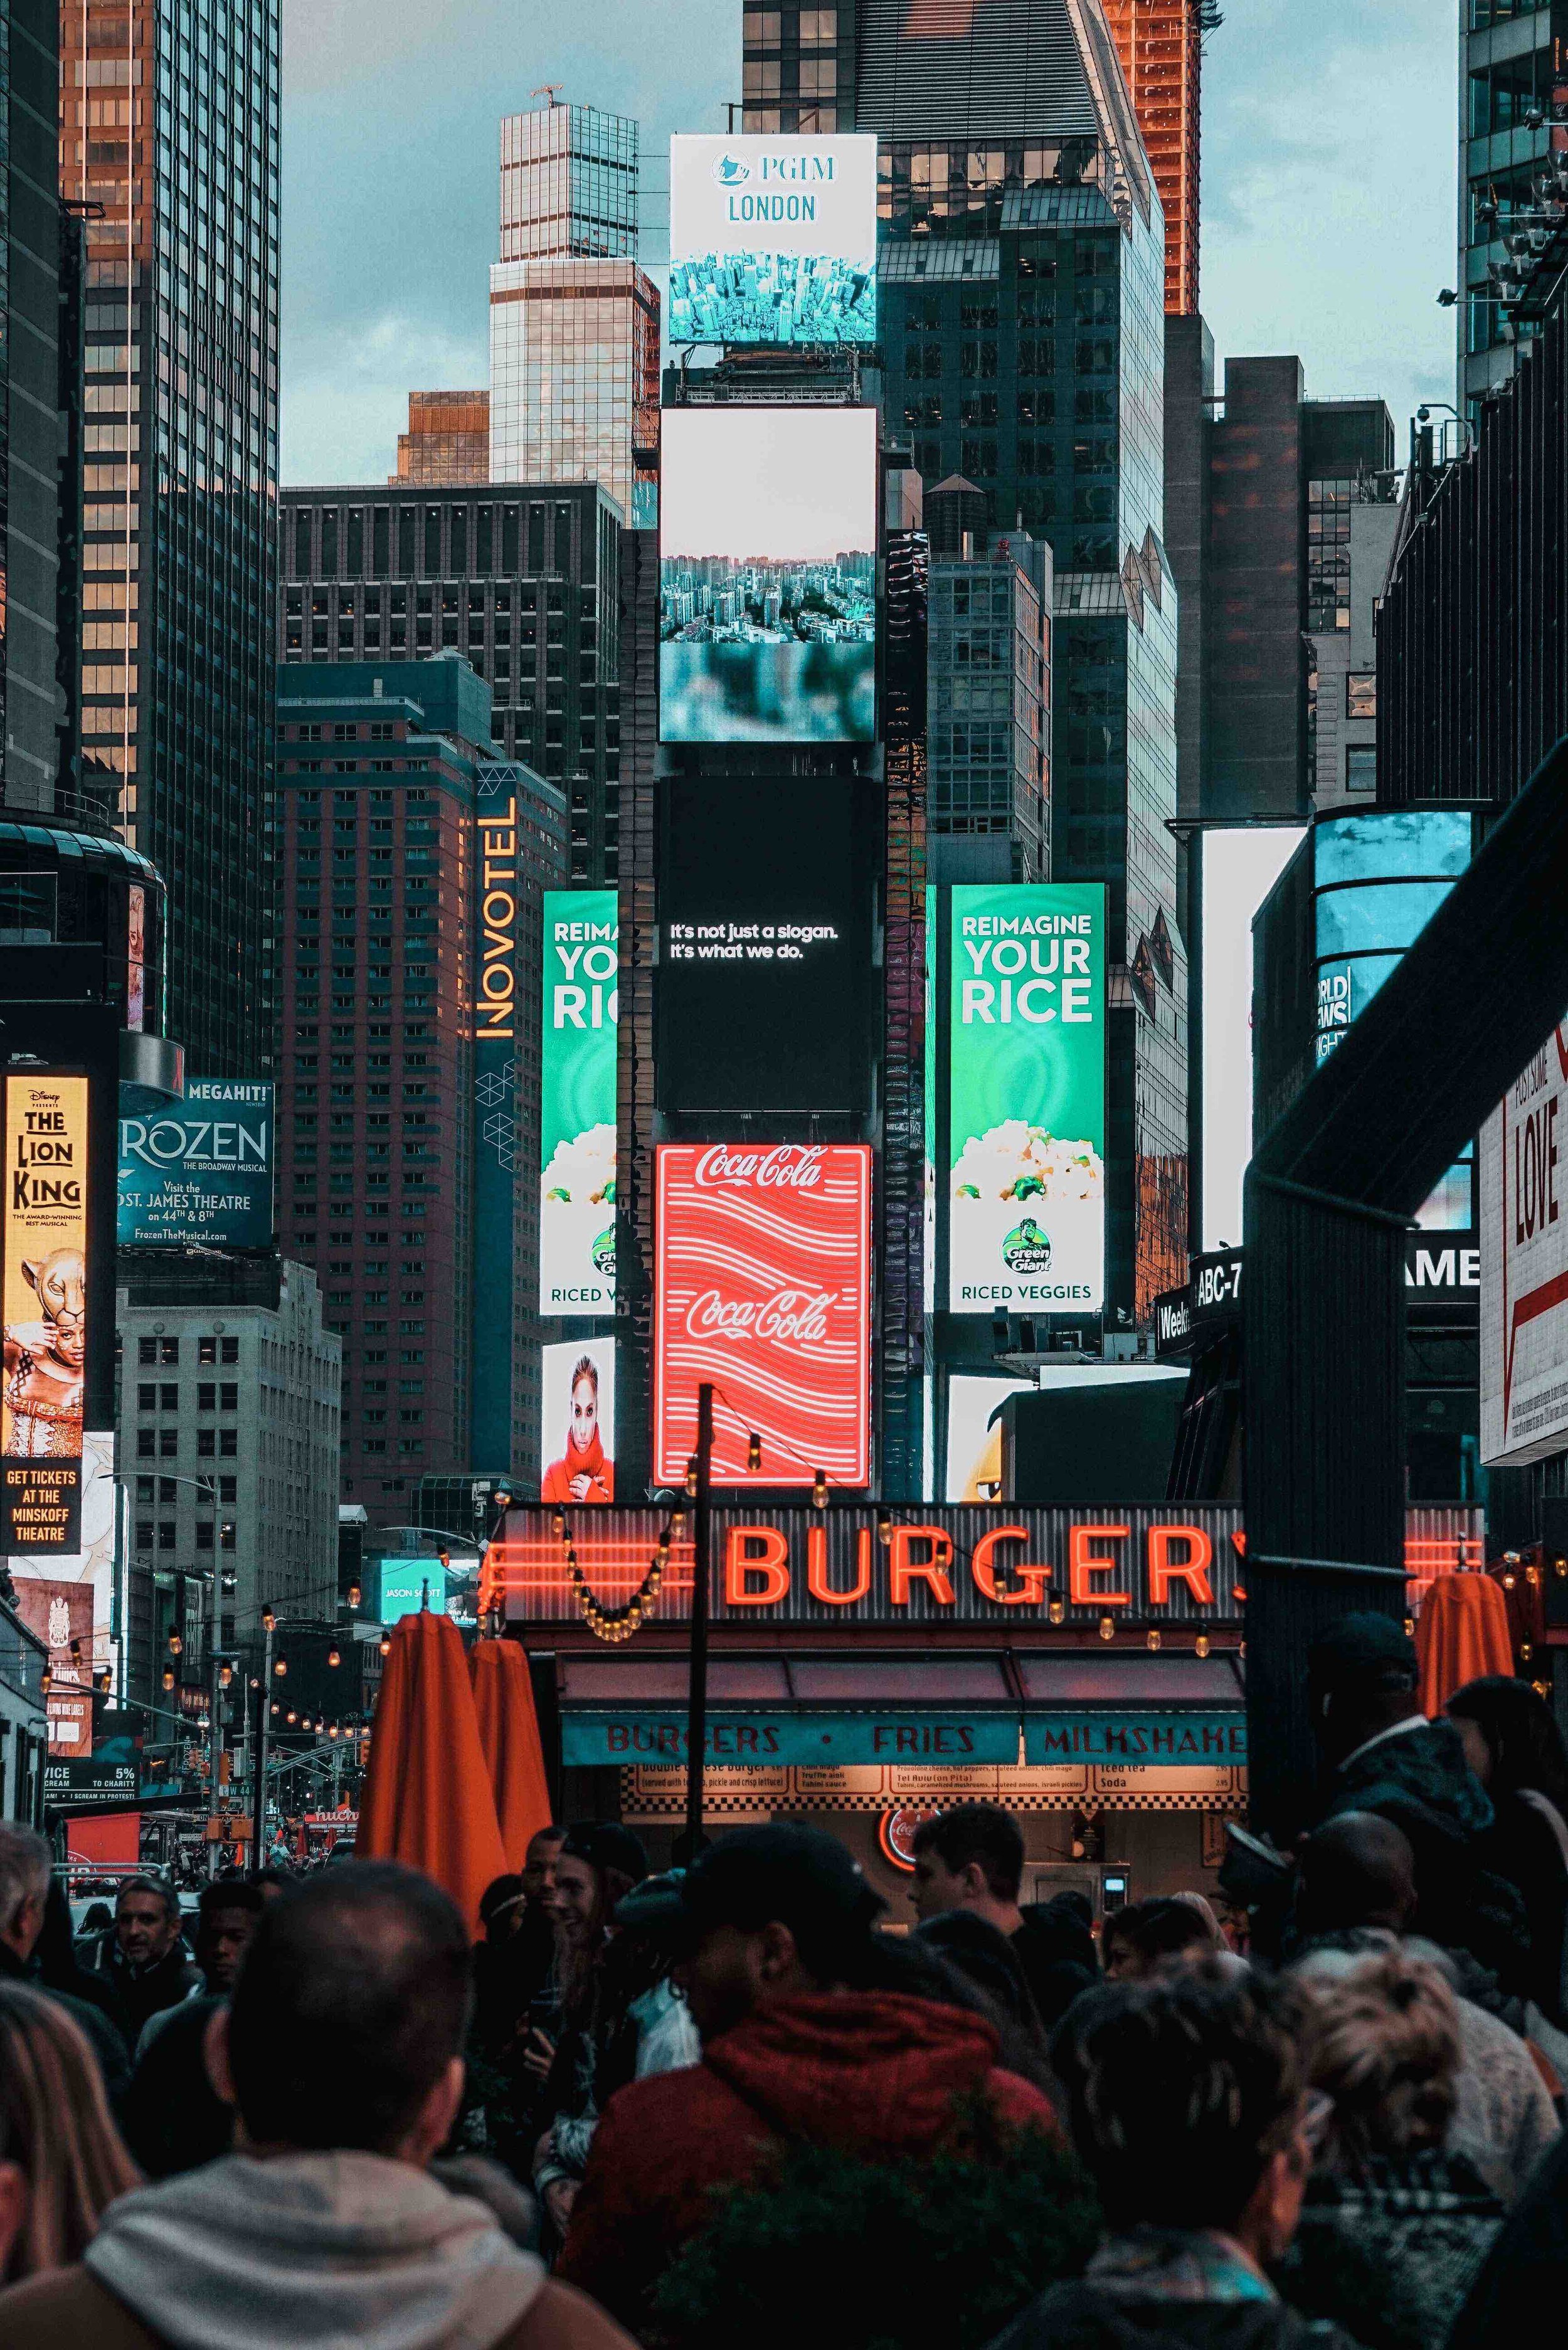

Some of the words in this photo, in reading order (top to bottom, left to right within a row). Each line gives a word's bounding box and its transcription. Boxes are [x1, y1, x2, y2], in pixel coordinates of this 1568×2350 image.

[763, 157, 834, 180] PGIM
[729, 195, 815, 221] LONDON
[477, 797, 516, 1037] NOVOTEL
[962, 915, 1091, 936] REIMAGINE
[670, 924, 694, 938] It's
[697, 925, 725, 938] not
[727, 923, 760, 942] just
[762, 927, 775, 938] a
[777, 924, 839, 943] slogan.
[670, 945, 694, 958] It's
[698, 945, 743, 958] what
[746, 946, 773, 958] we
[777, 945, 803, 958] do.
[963, 938, 1090, 975] YOUR
[962, 978, 1093, 1024] RICE
[24, 1112, 65, 1130] THE
[198, 1163, 236, 1171] BROADWAY
[238, 1164, 267, 1172] MUSICAL
[694, 1143, 829, 1188] Coca-Cola
[1515, 1094, 1558, 1247] LOVE
[164, 1182, 184, 1193] Visit
[186, 1182, 200, 1193] the
[146, 1194, 189, 1208] JAMES
[193, 1195, 250, 1210] THEATRE
[188, 1211, 196, 1222] &
[135, 1228, 227, 1241] FrozenTheMusical.com
[1007, 1247, 1050, 1259] Green
[1011, 1259, 1052, 1271] Giant
[1198, 1262, 1242, 1306] ABC-7
[552, 1289, 601, 1301] RICED
[962, 1286, 1012, 1299] RICED
[1018, 1286, 1091, 1299] VEGGIES
[686, 1289, 838, 1340] Coca-Cola
[7, 1471, 28, 1485] GET
[30, 1471, 76, 1485] TICKETS
[22, 1490, 36, 1503] AT
[39, 1490, 60, 1503] THE
[12, 1508, 69, 1522] MINSKOFF
[16, 1527, 65, 1540] THEATRE
[386, 1589, 413, 1597] JASON
[874, 1726, 975, 1754] FRIES
[115, 1767, 135, 1779] 5%
[1101, 1777, 1126, 1787] Soda
[230, 1786, 237, 1795] W
[240, 1786, 250, 1795] 44
